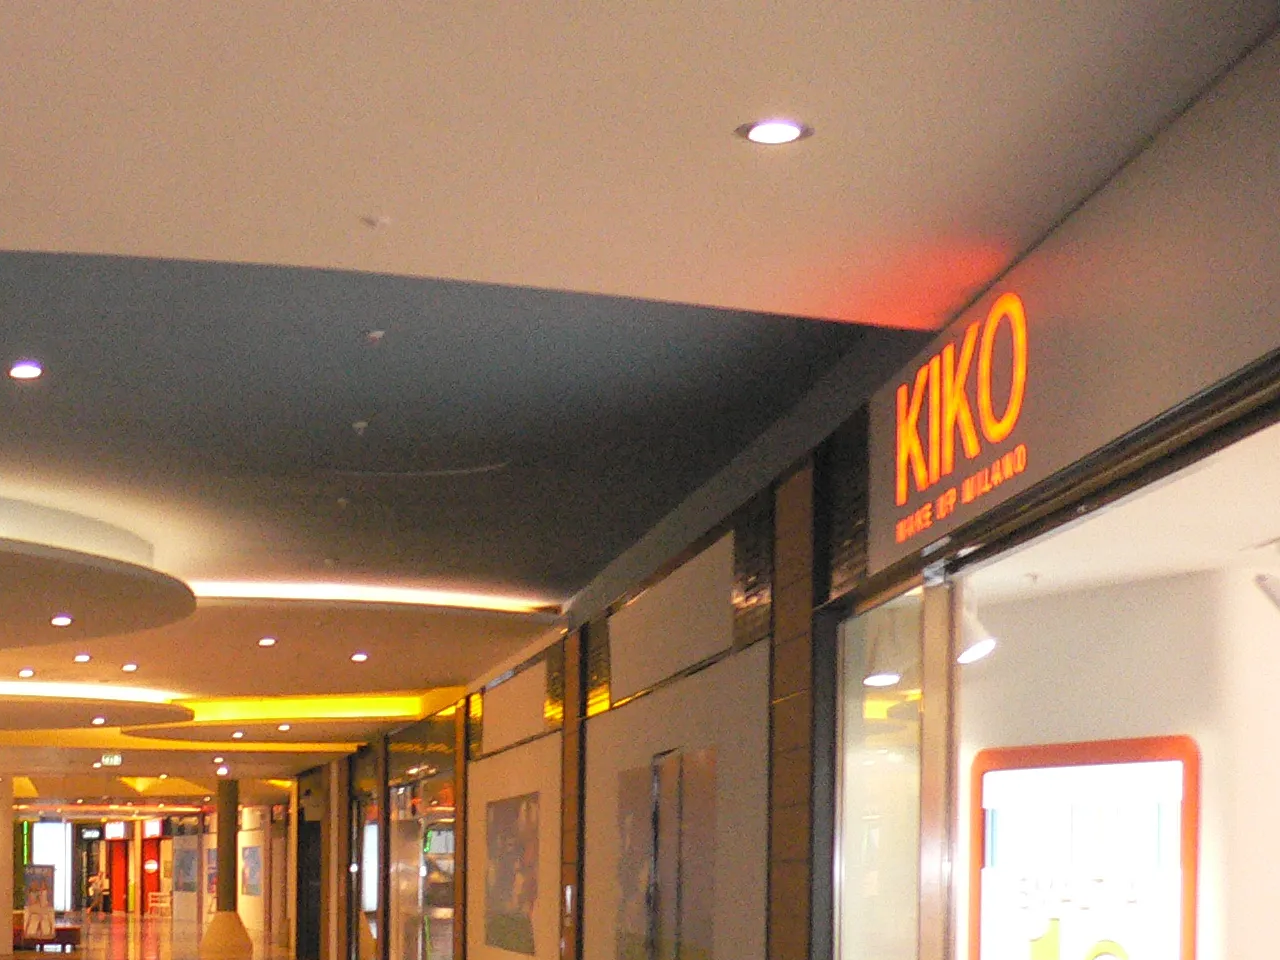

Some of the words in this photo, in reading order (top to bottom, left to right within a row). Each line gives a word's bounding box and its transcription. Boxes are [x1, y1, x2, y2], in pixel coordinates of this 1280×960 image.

[895, 292, 1028, 506] KIKO
[895, 502, 934, 543] MAKE
[936, 487, 957, 520] UP
[961, 443, 1028, 504] MILANO
